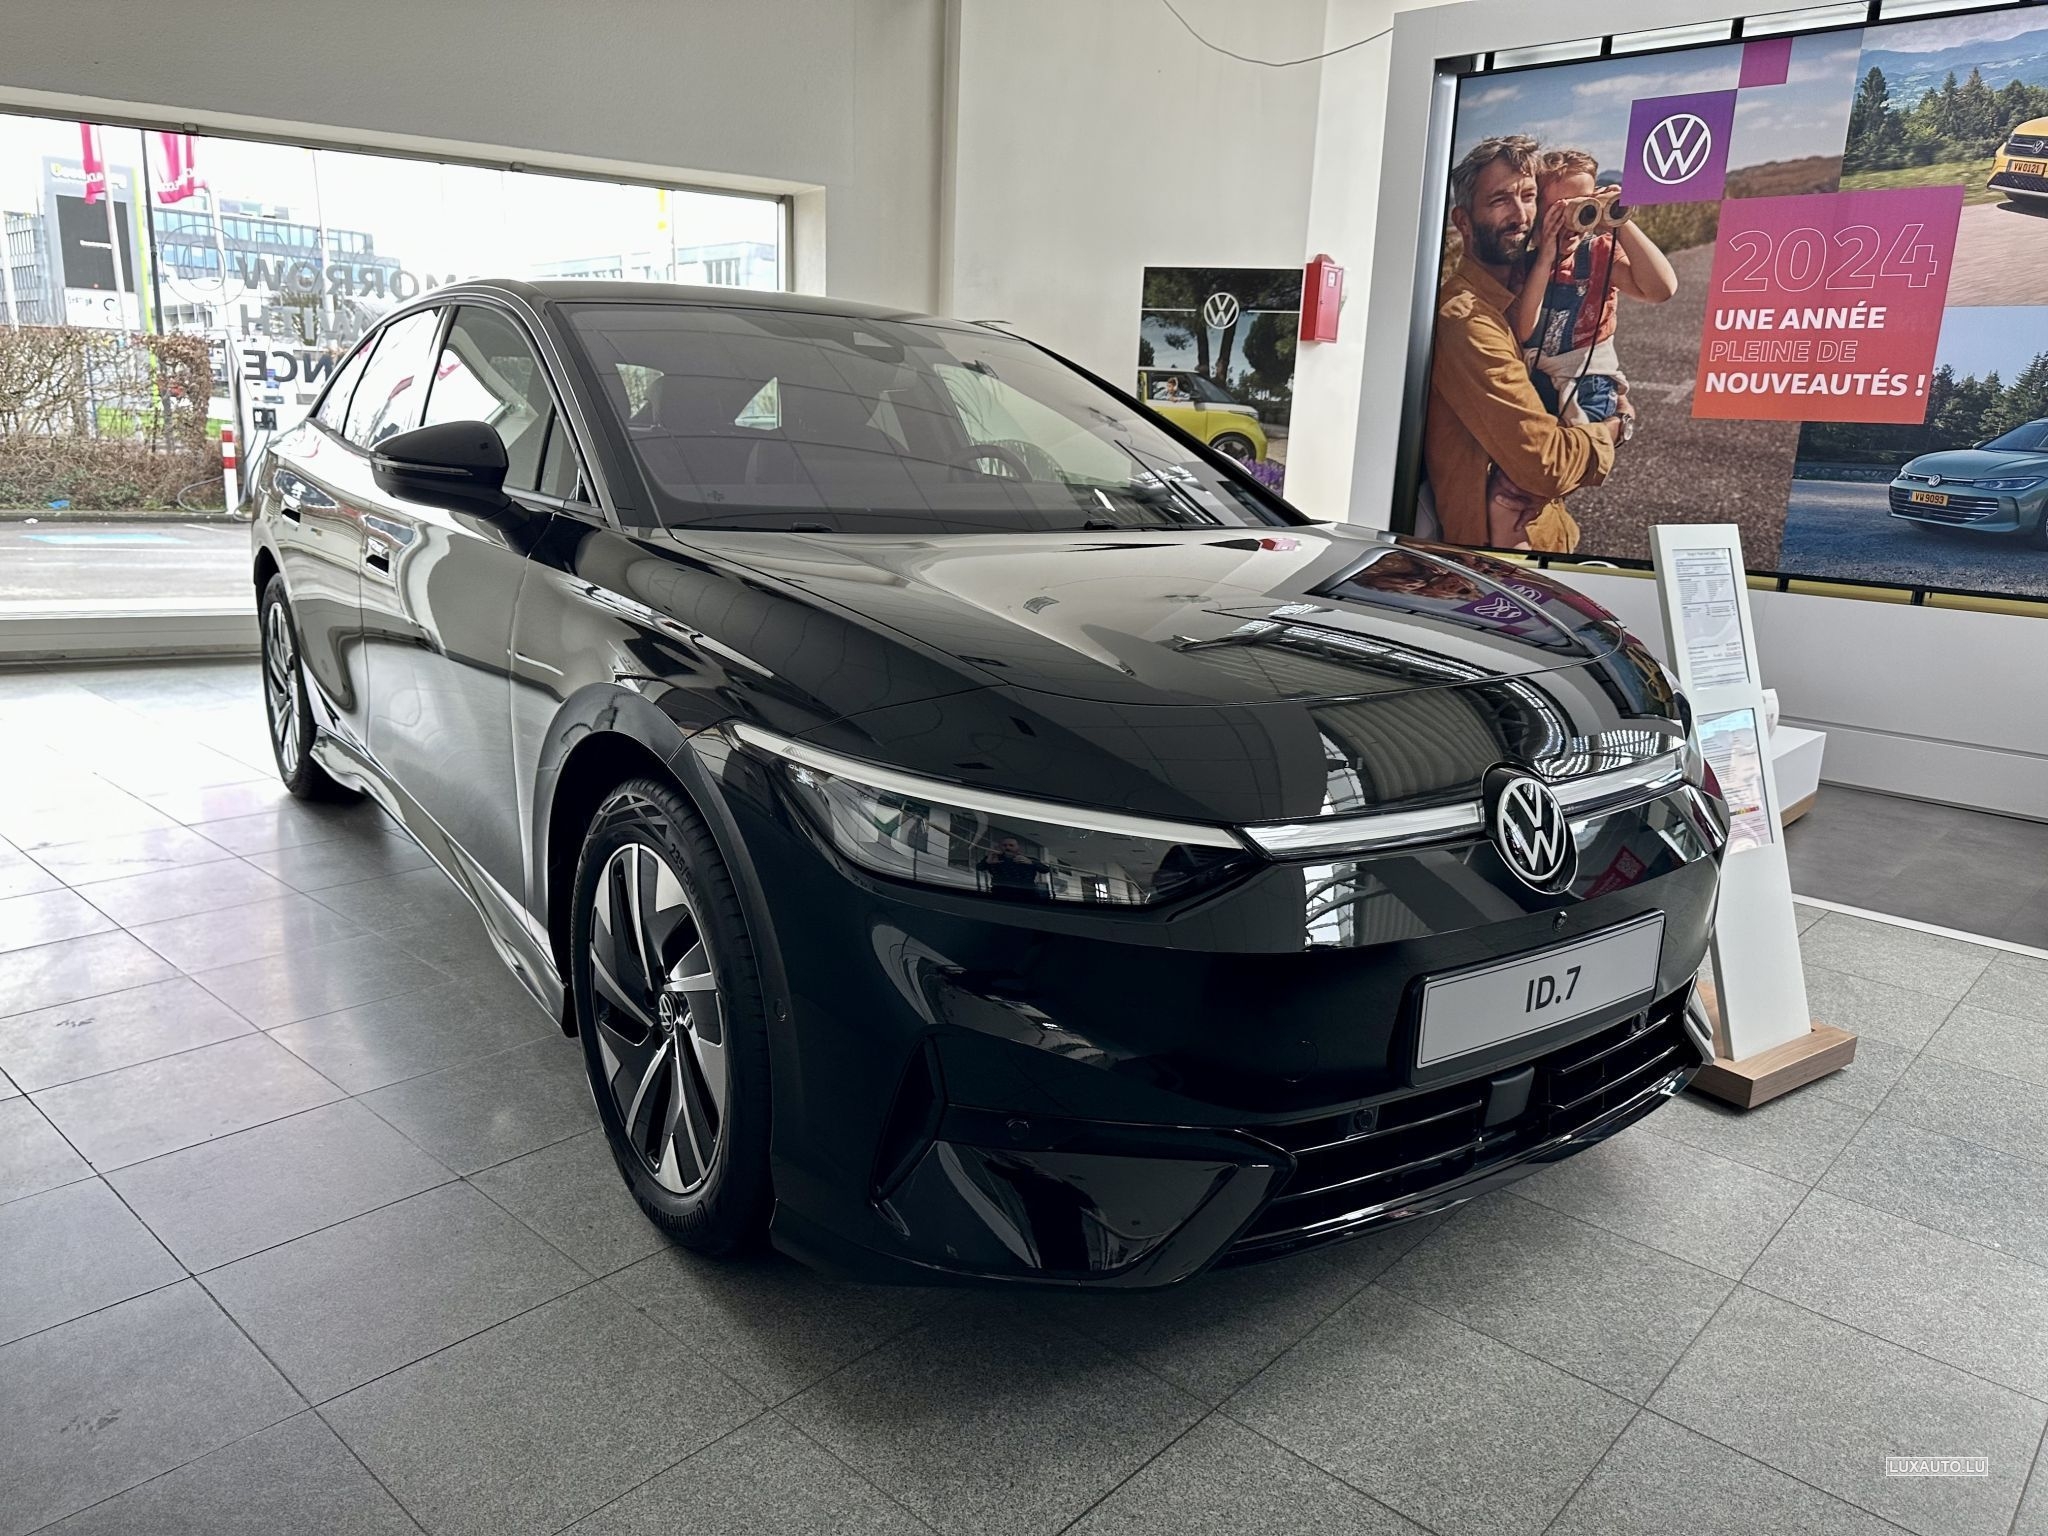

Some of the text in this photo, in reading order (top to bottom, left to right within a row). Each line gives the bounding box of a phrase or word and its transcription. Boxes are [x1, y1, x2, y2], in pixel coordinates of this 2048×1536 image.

[1722, 223, 1938, 292] 2024
[1714, 301, 1887, 331] UNE ANNÉE
[1708, 340, 1859, 363] PLEINE DE
[1705, 367, 1909, 396] NOUVEAUTÉS
[1525, 965, 1582, 1013] ID.7
